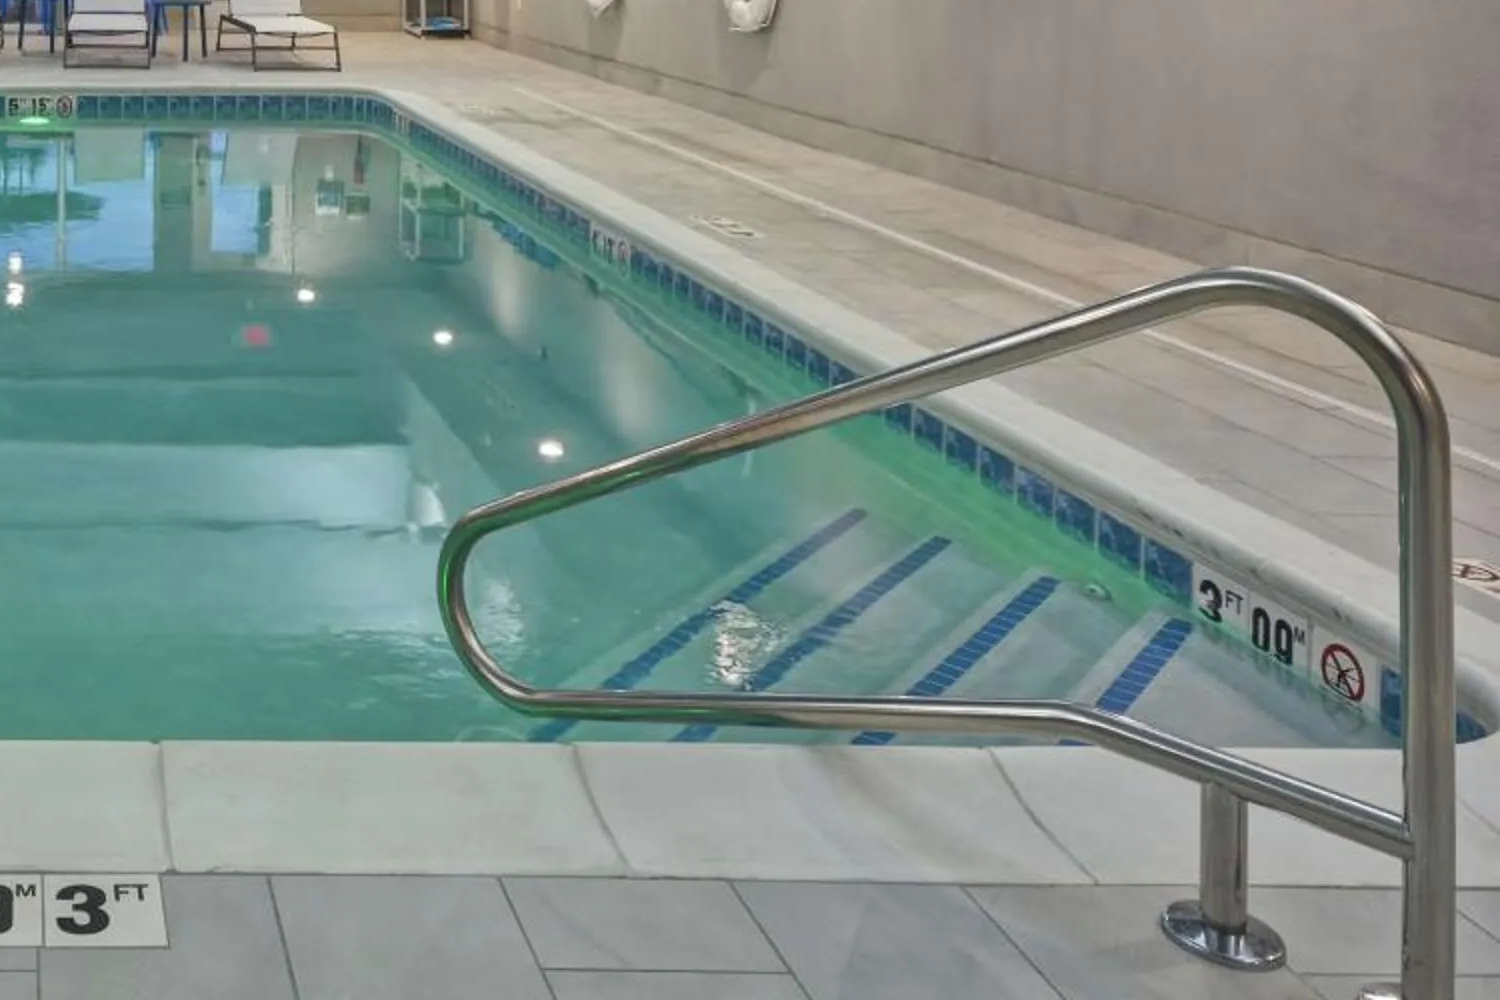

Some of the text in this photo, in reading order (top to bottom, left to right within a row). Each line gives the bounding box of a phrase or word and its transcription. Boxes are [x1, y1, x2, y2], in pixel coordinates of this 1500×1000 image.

[1198, 580, 1244, 622] 3 FT
[15, 884, 37, 897] M
[55, 884, 150, 935] 3 FT
